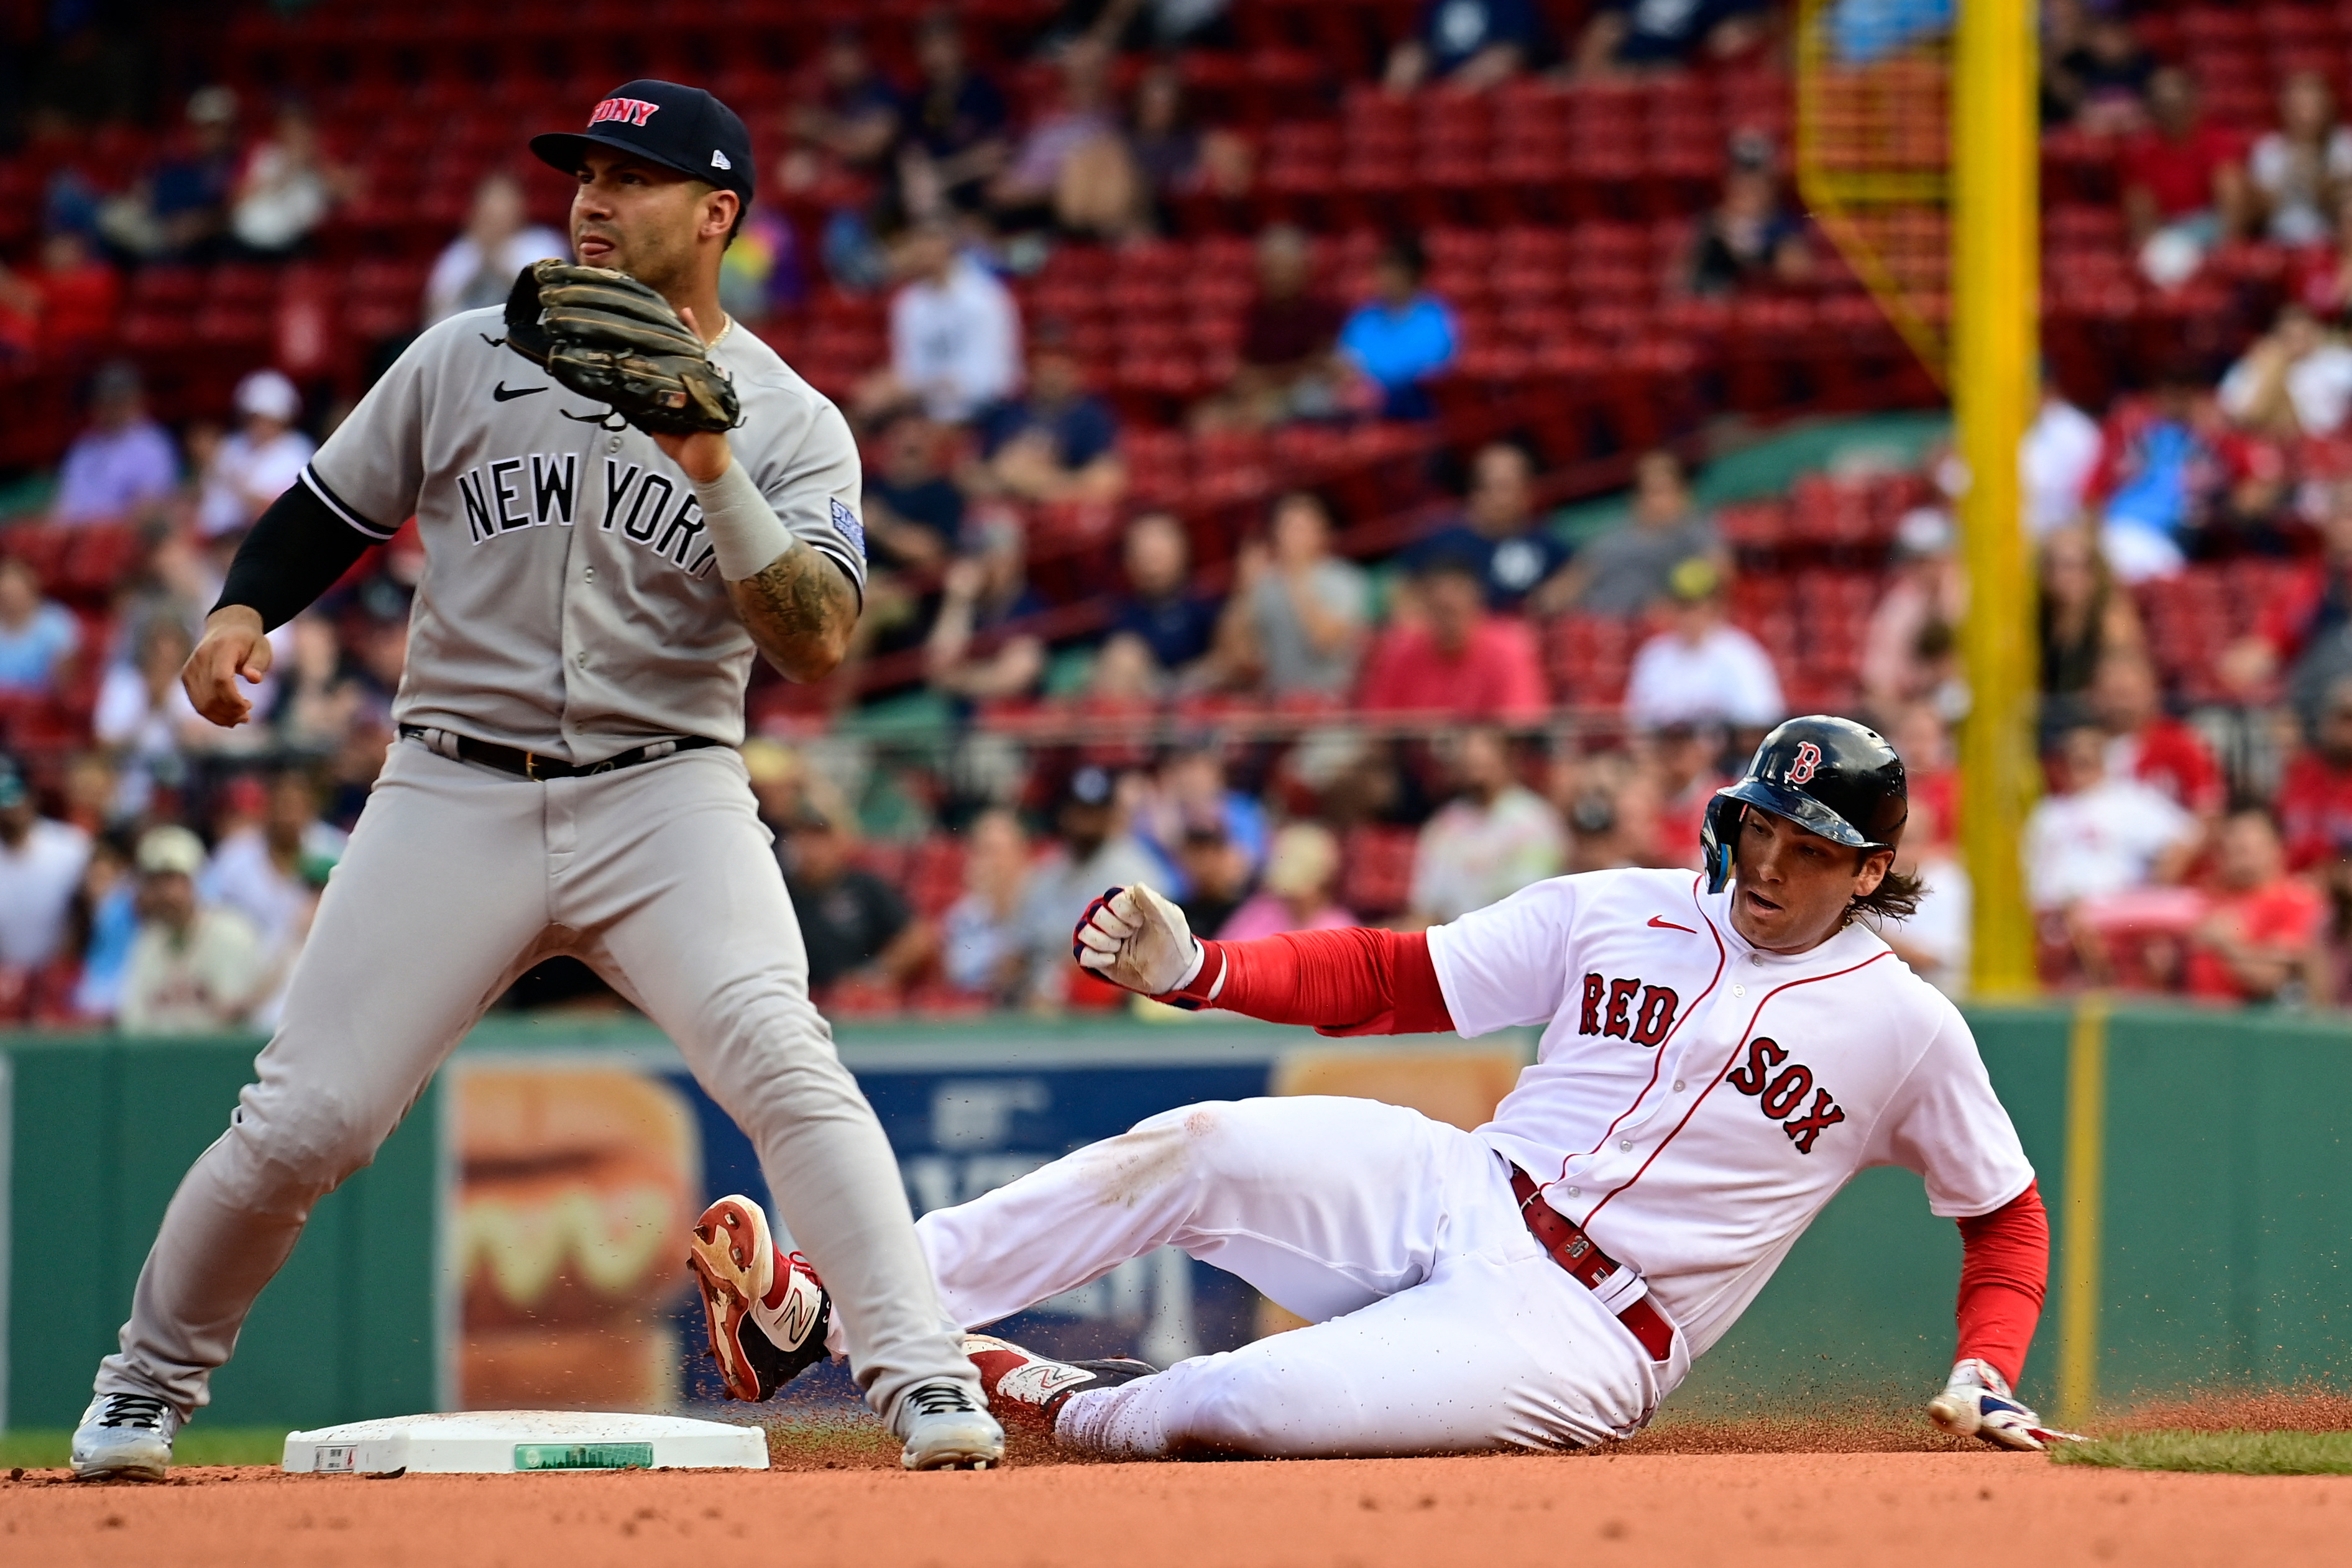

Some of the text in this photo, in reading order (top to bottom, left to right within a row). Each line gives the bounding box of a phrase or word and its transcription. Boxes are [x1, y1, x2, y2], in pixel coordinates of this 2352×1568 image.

[456, 452, 579, 546] NEW
[1785, 741, 1822, 784] B
[1578, 972, 1679, 1048] RED
[1726, 1037, 1845, 1155] SOX
[1565, 1235, 1589, 1259] 36
